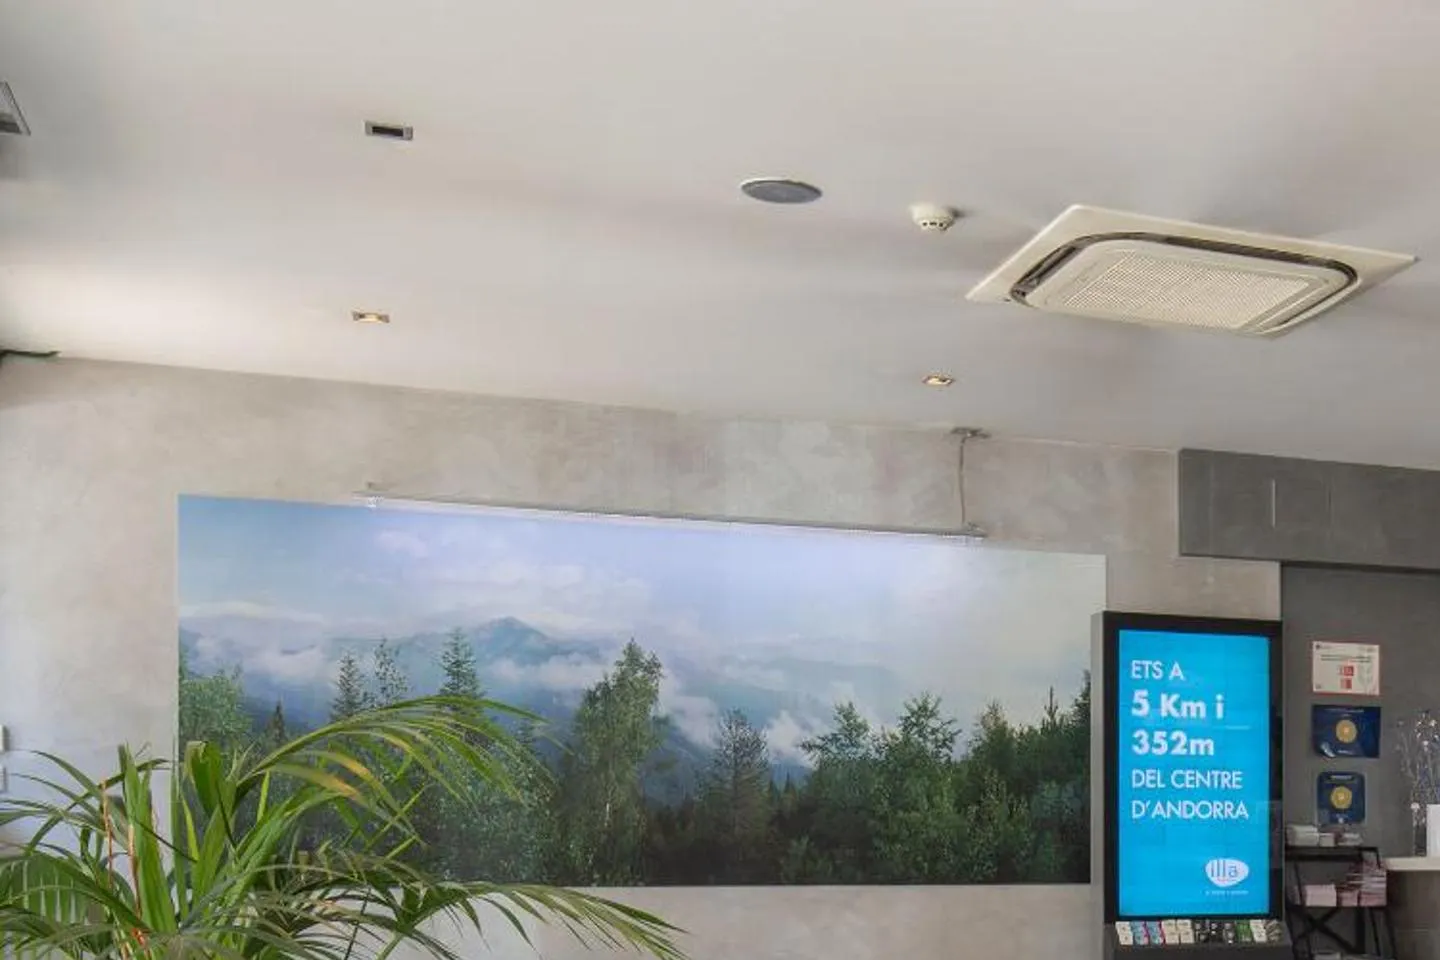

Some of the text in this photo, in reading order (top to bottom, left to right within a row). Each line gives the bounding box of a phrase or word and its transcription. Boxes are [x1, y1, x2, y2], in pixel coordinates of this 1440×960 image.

[1131, 659, 1186, 681] ETS A
[1131, 689, 1225, 720] 5 Km i
[1131, 728, 1215, 756] 352m
[1131, 768, 1244, 790] DEL CENTRE
